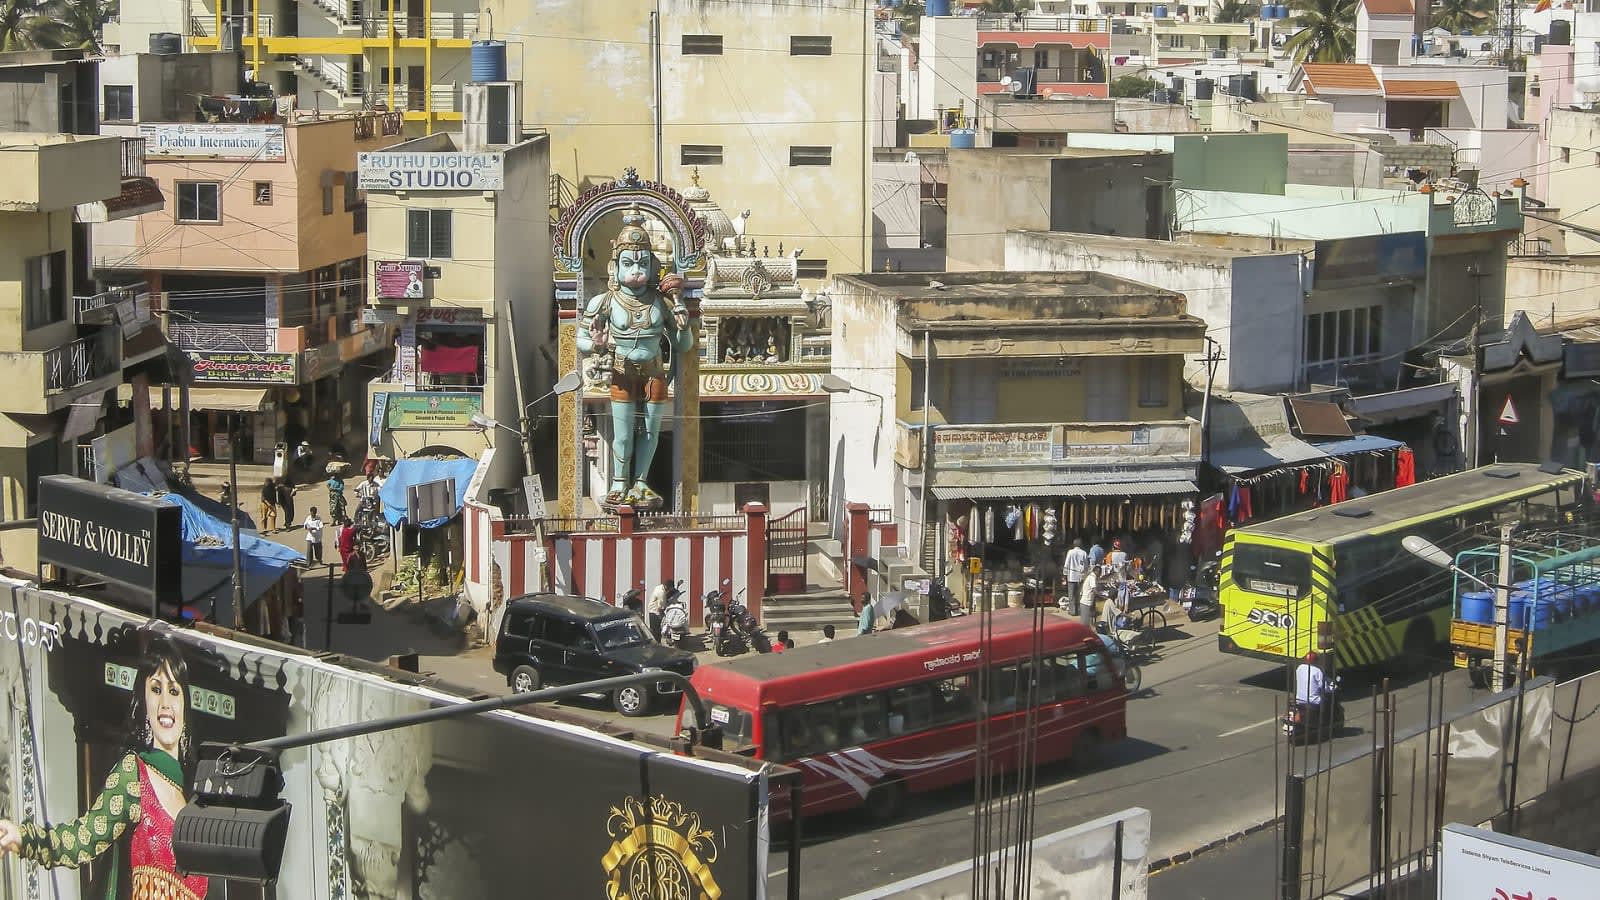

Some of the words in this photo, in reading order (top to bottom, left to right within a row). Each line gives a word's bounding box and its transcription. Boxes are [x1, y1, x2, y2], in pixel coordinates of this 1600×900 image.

[160, 135, 196, 148] Prabhu
[371, 155, 425, 168] RUTHU
[430, 154, 491, 168] DIGITAL
[389, 169, 473, 187] STUDIO
[194, 360, 293, 373] Anugraha
[42, 510, 81, 547] SERVE
[84, 520, 98, 552] &
[99, 525, 151, 568] VOLLEY
